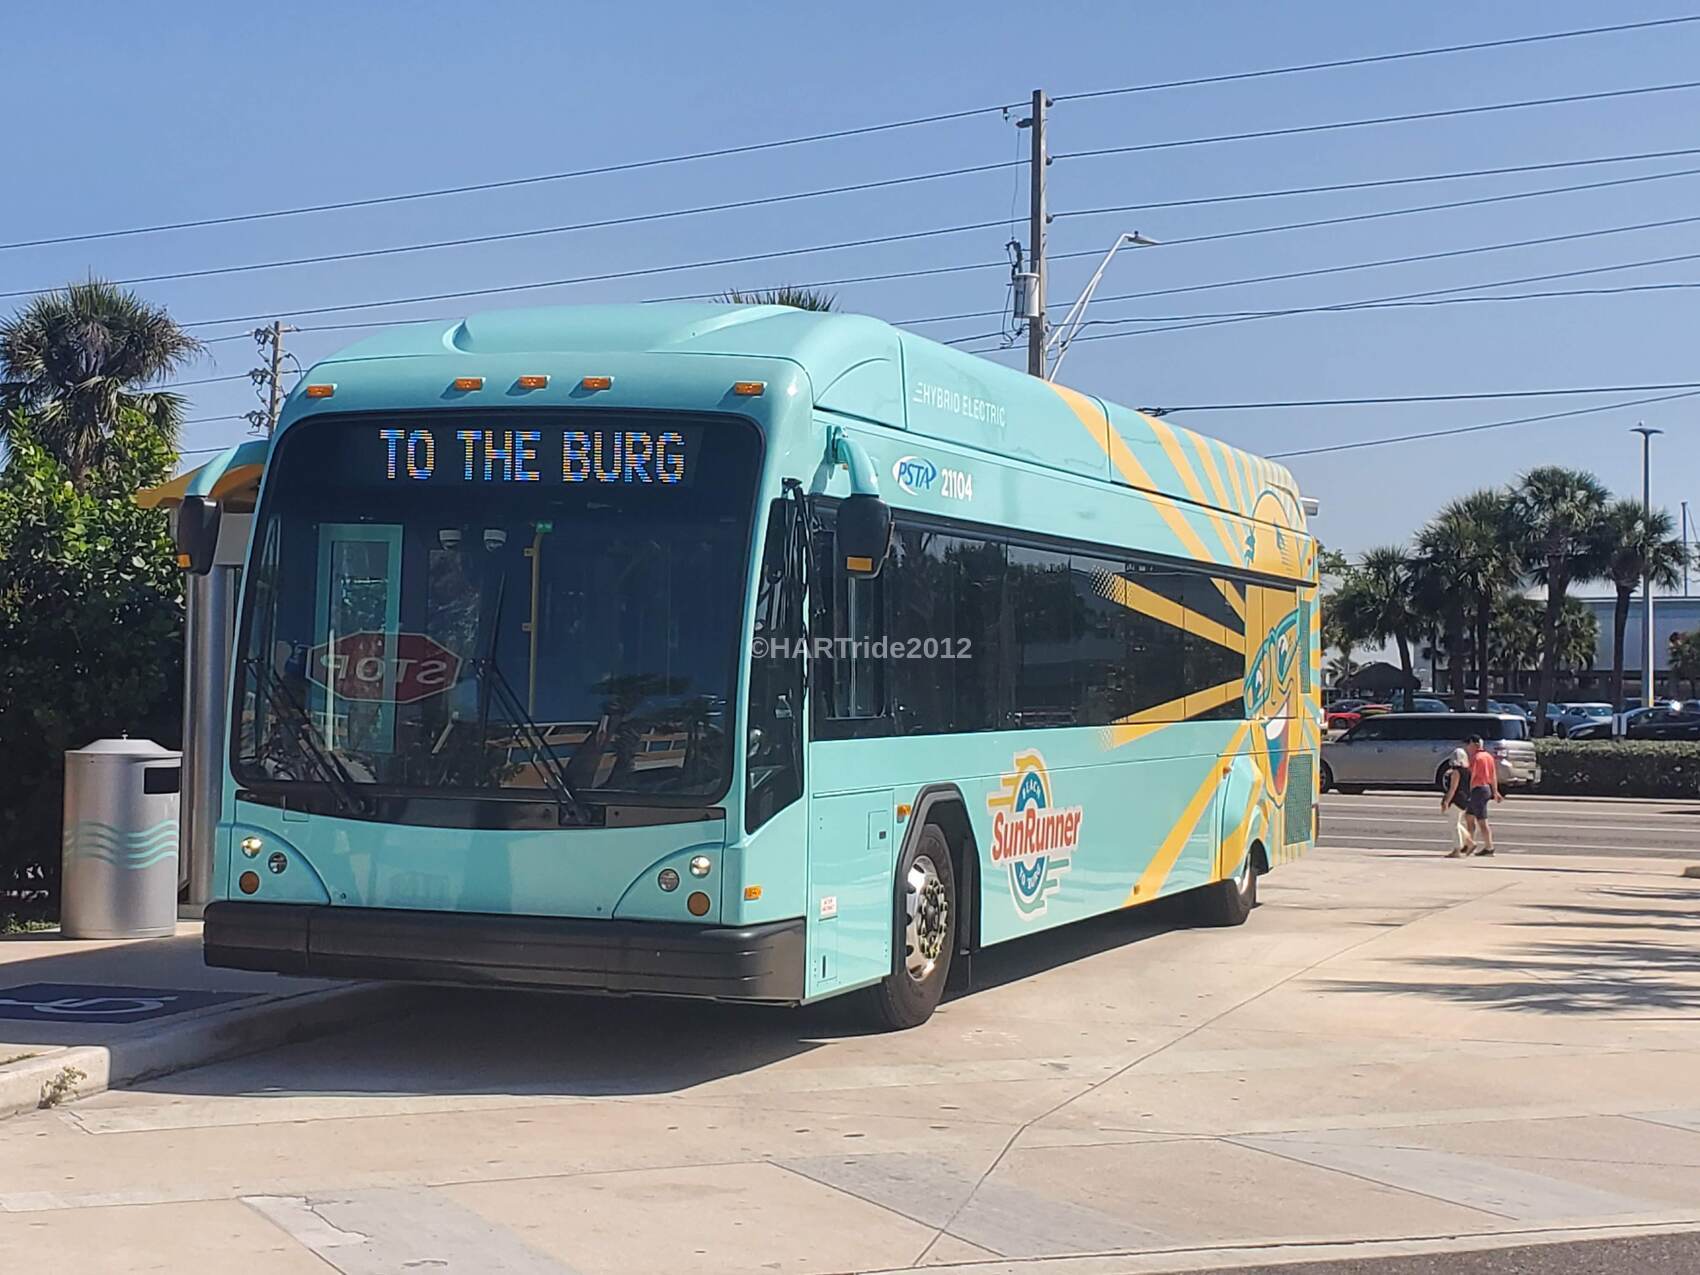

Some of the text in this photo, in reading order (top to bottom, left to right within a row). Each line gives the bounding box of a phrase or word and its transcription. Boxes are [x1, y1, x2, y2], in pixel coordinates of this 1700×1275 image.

[923, 383, 1006, 427] HYBRID ELECTRIC
[380, 429, 685, 483] TO THE BURG
[897, 460, 936, 490] PSTA
[941, 468, 973, 501] 21104
[992, 808, 1081, 861] SunRunner
